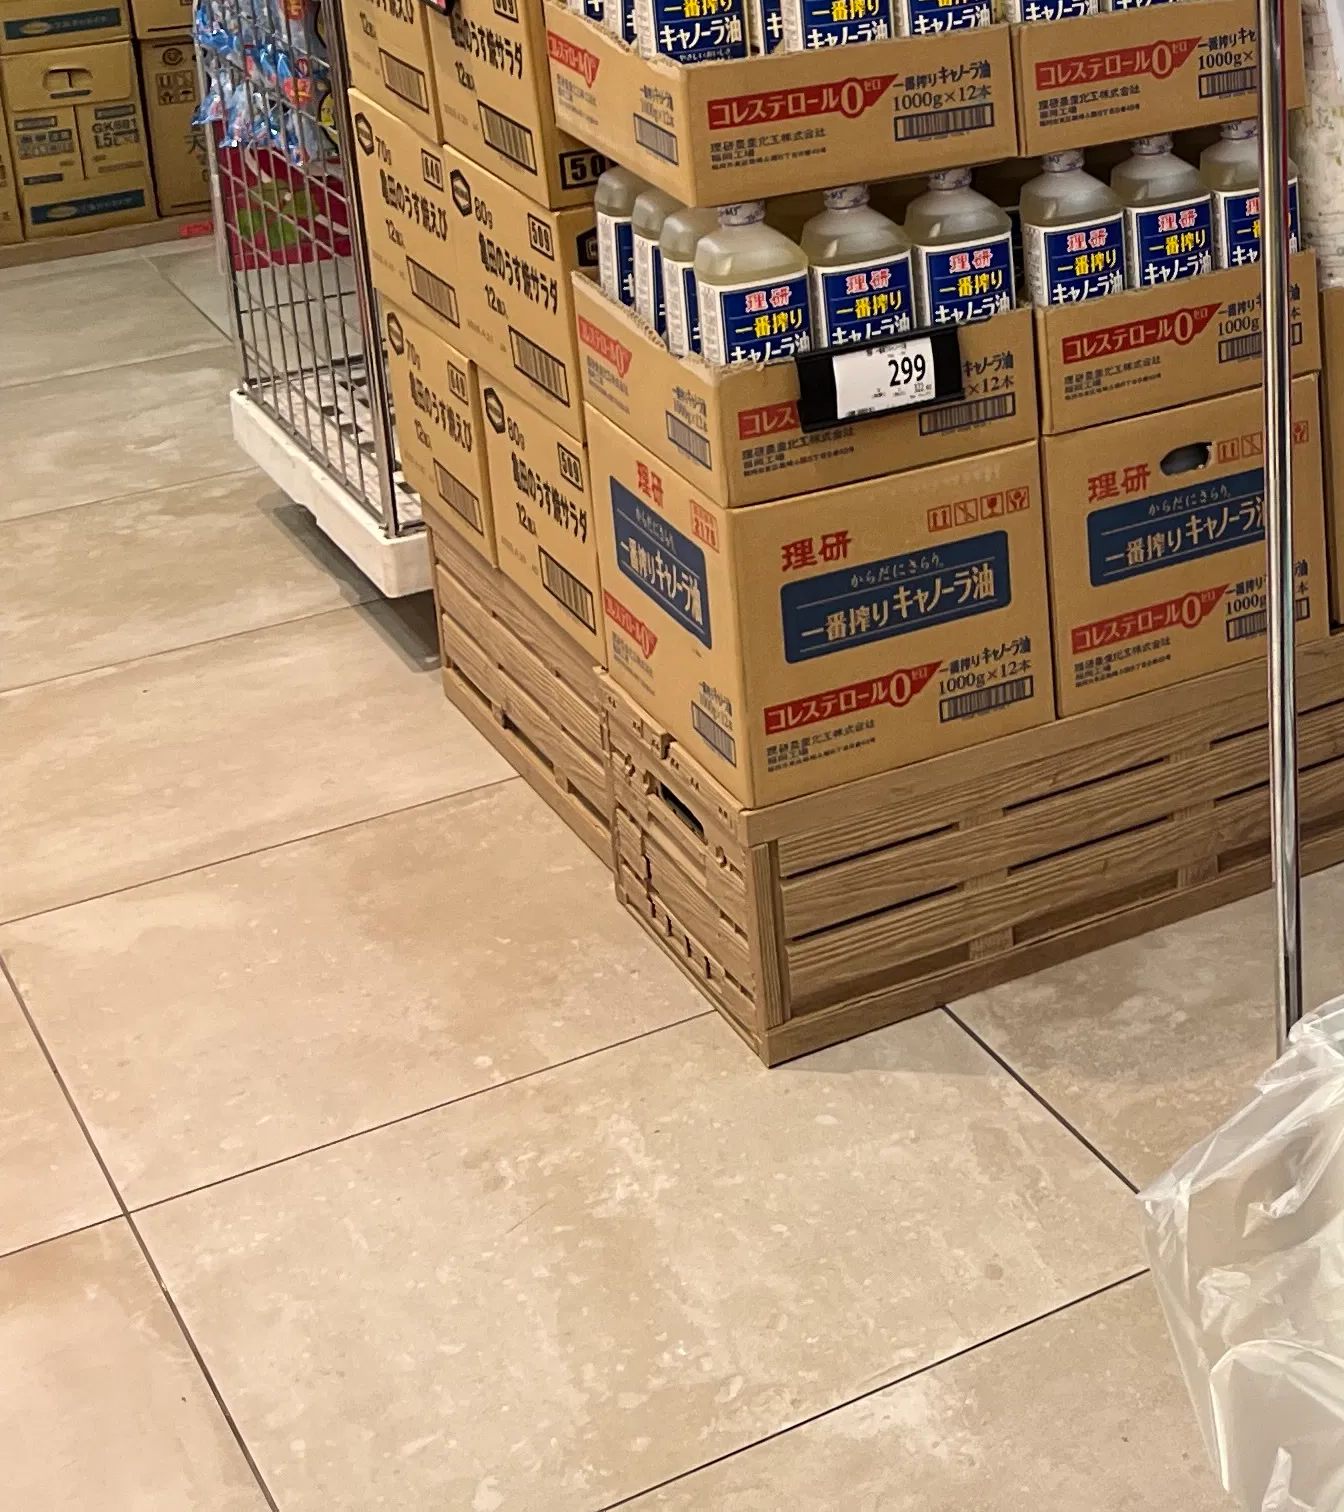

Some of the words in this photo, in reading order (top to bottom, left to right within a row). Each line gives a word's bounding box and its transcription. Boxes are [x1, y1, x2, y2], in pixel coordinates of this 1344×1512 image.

[659, 15, 742, 52] キャノーラ油
[474, 195, 492, 230] 80g
[736, 308, 803, 339] 一番搾り
[836, 293, 903, 319] 一番搾り
[888, 354, 926, 387] 299
[1088, 462, 1151, 504] 理研
[781, 530, 852, 571] 理研
[801, 562, 995, 643] 一番搾りキャノーラ油
